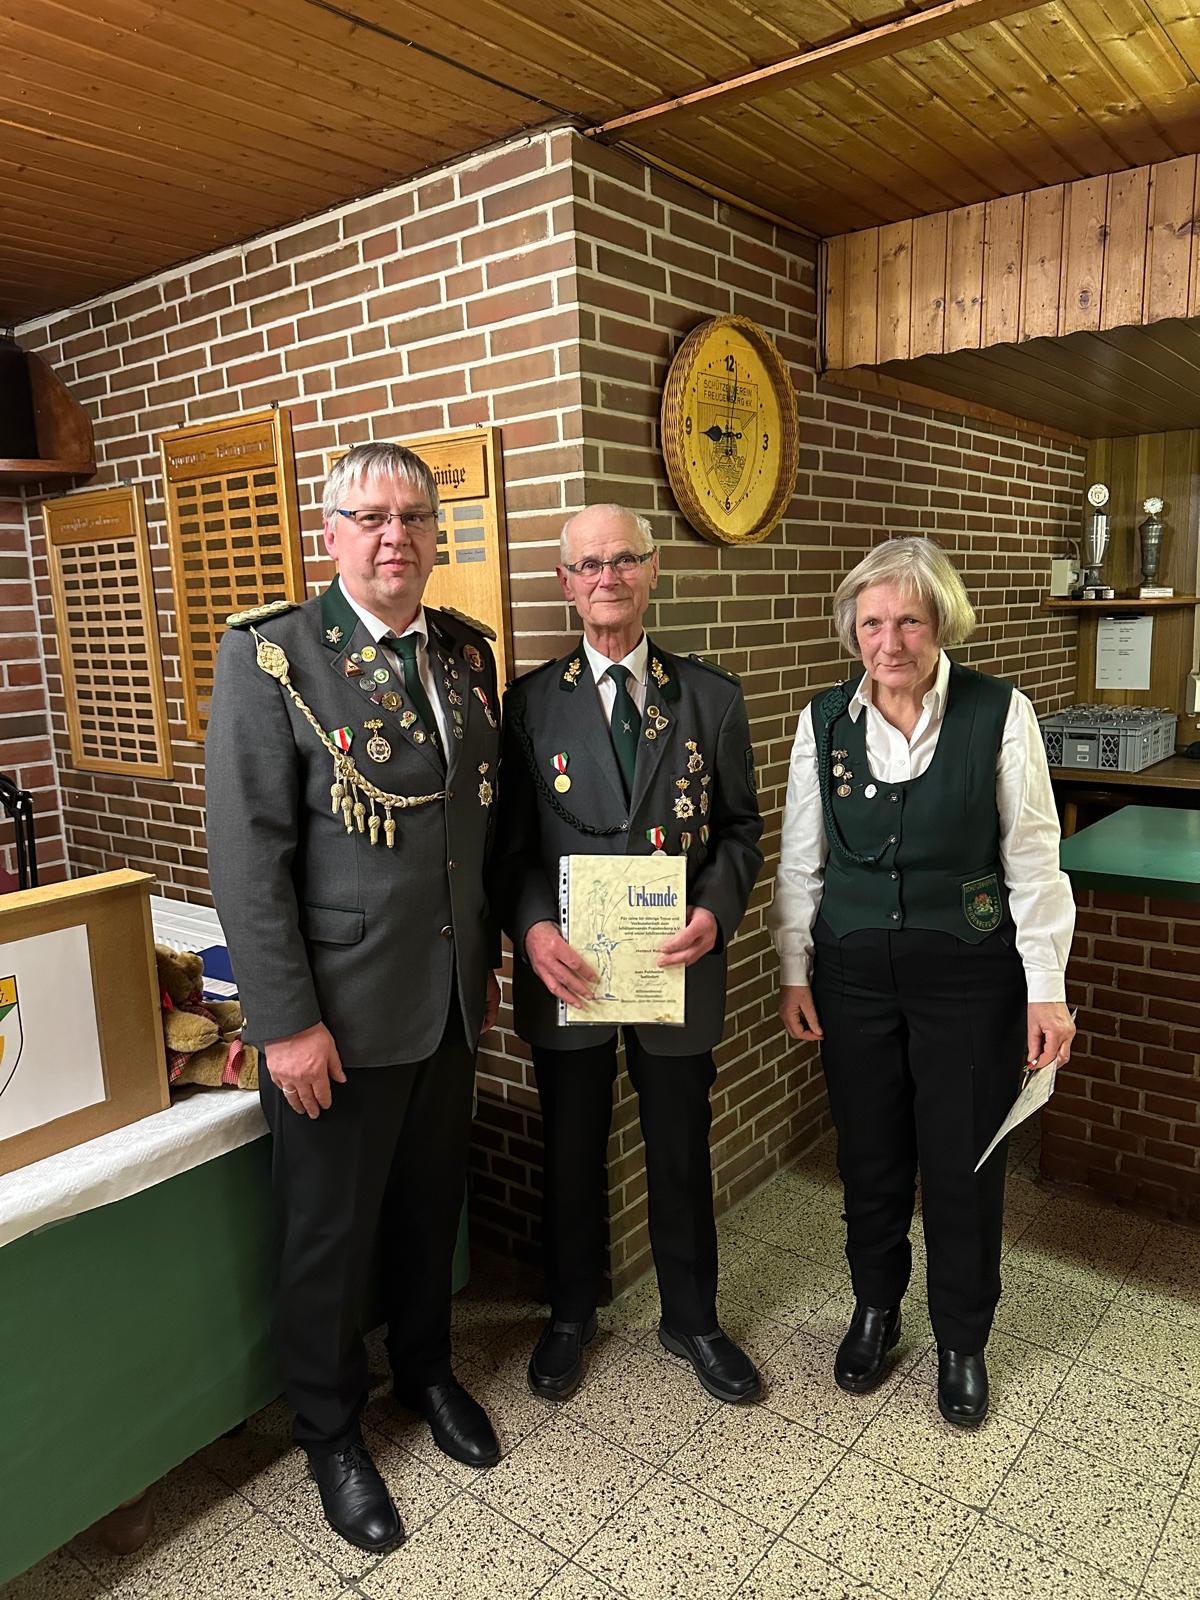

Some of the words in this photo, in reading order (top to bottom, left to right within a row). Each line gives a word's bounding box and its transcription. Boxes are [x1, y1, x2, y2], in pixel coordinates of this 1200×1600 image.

[725, 355, 734, 372] 12
[685, 416, 692, 435] 9
[762, 434, 769, 451] 3
[433, 463, 466, 489] önige
[725, 497, 731, 511] 6
[627, 885, 678, 907] Urkunde
